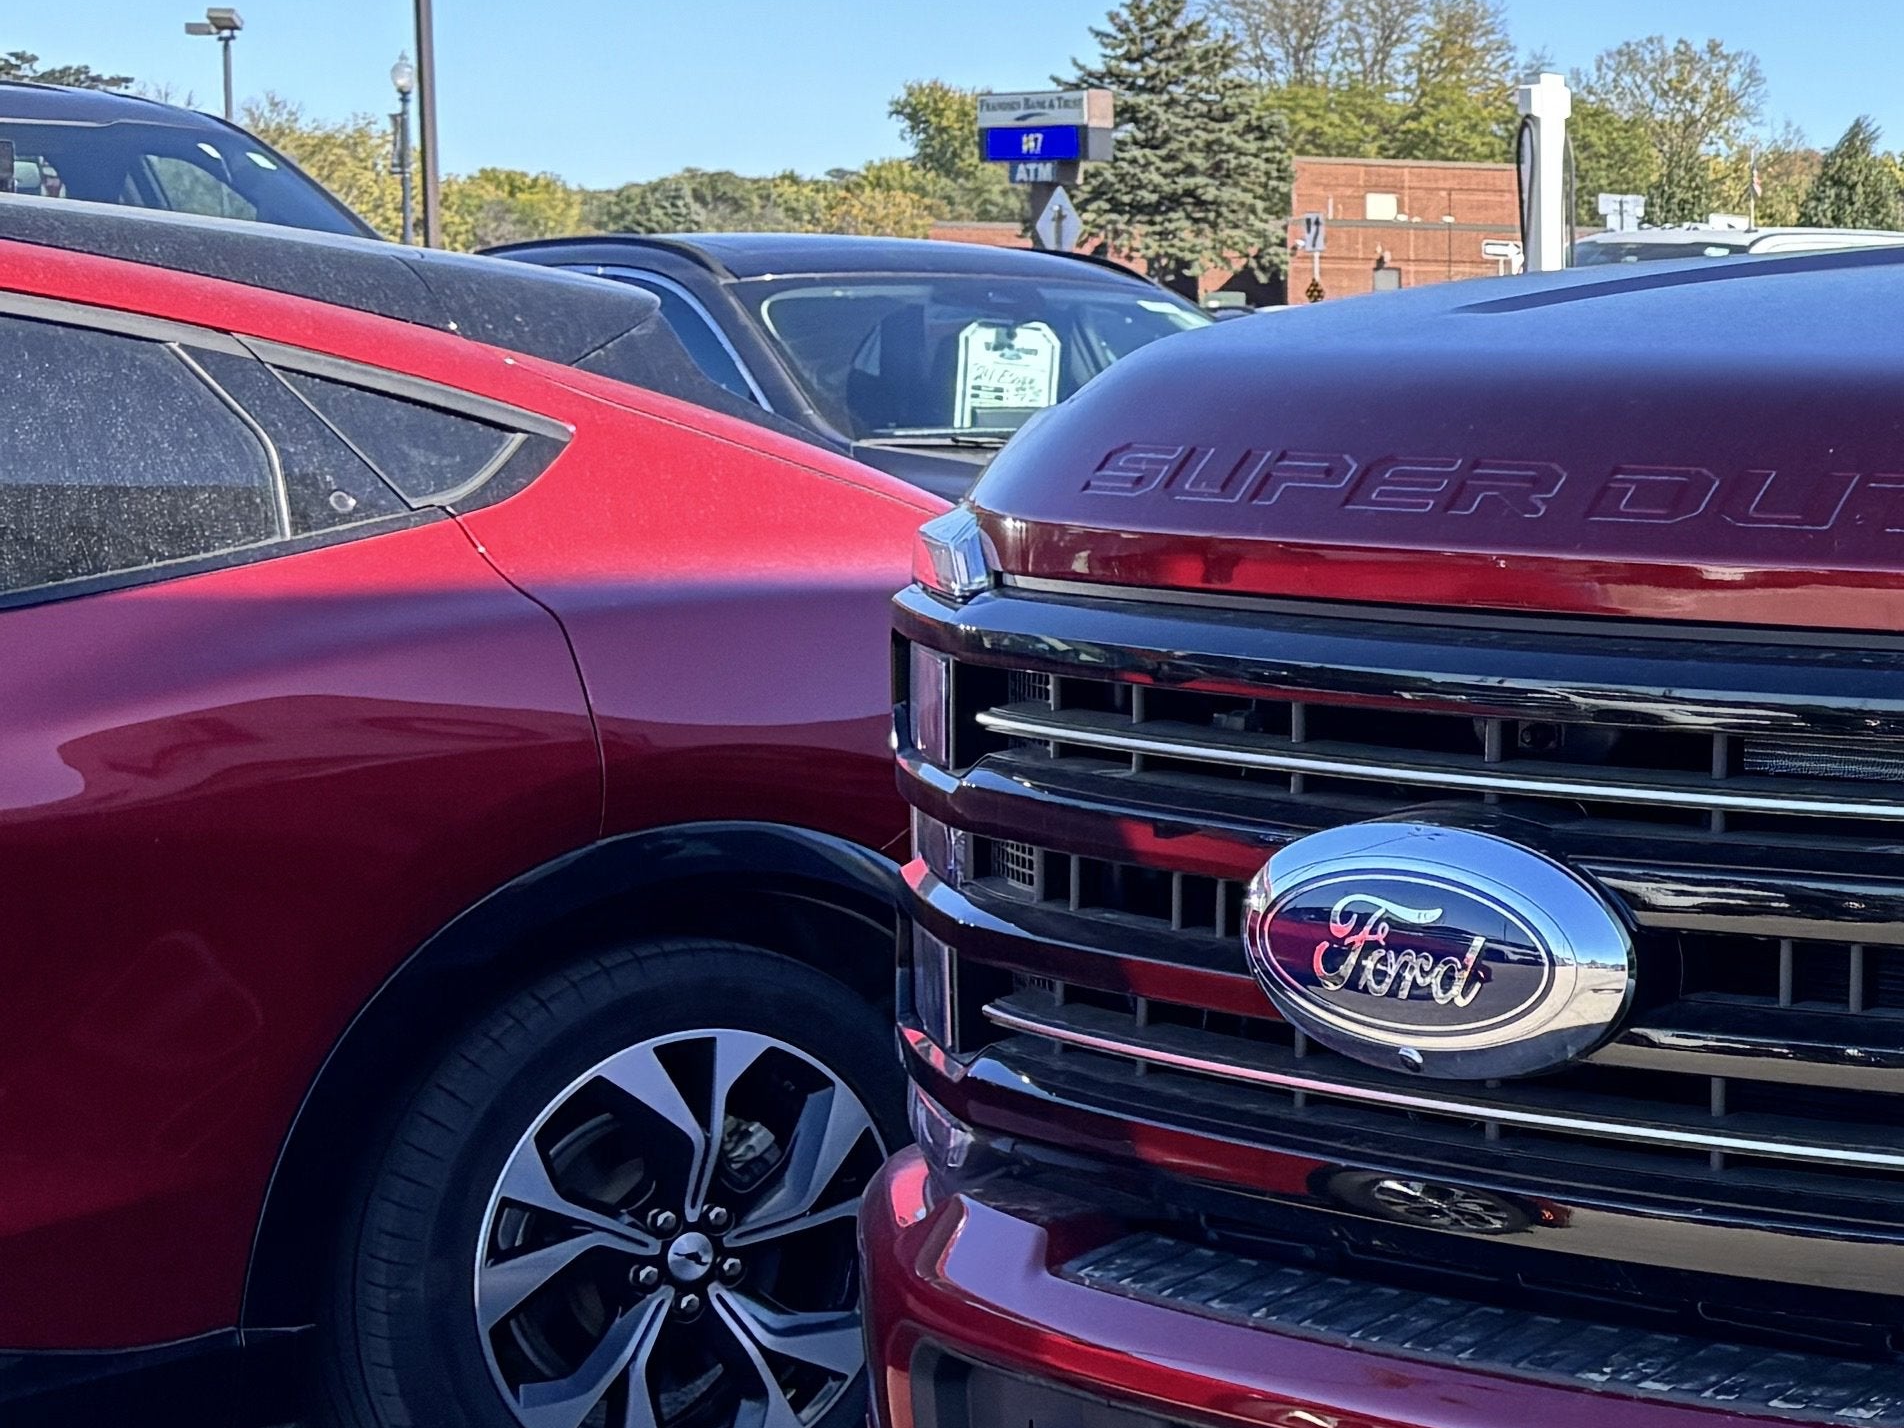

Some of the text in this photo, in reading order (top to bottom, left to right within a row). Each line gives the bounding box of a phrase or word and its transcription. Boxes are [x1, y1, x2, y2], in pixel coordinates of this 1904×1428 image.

[1015, 162, 1053, 182] ATM
[1080, 442, 1568, 519] SUPER
[1312, 892, 1488, 1009] Ford
